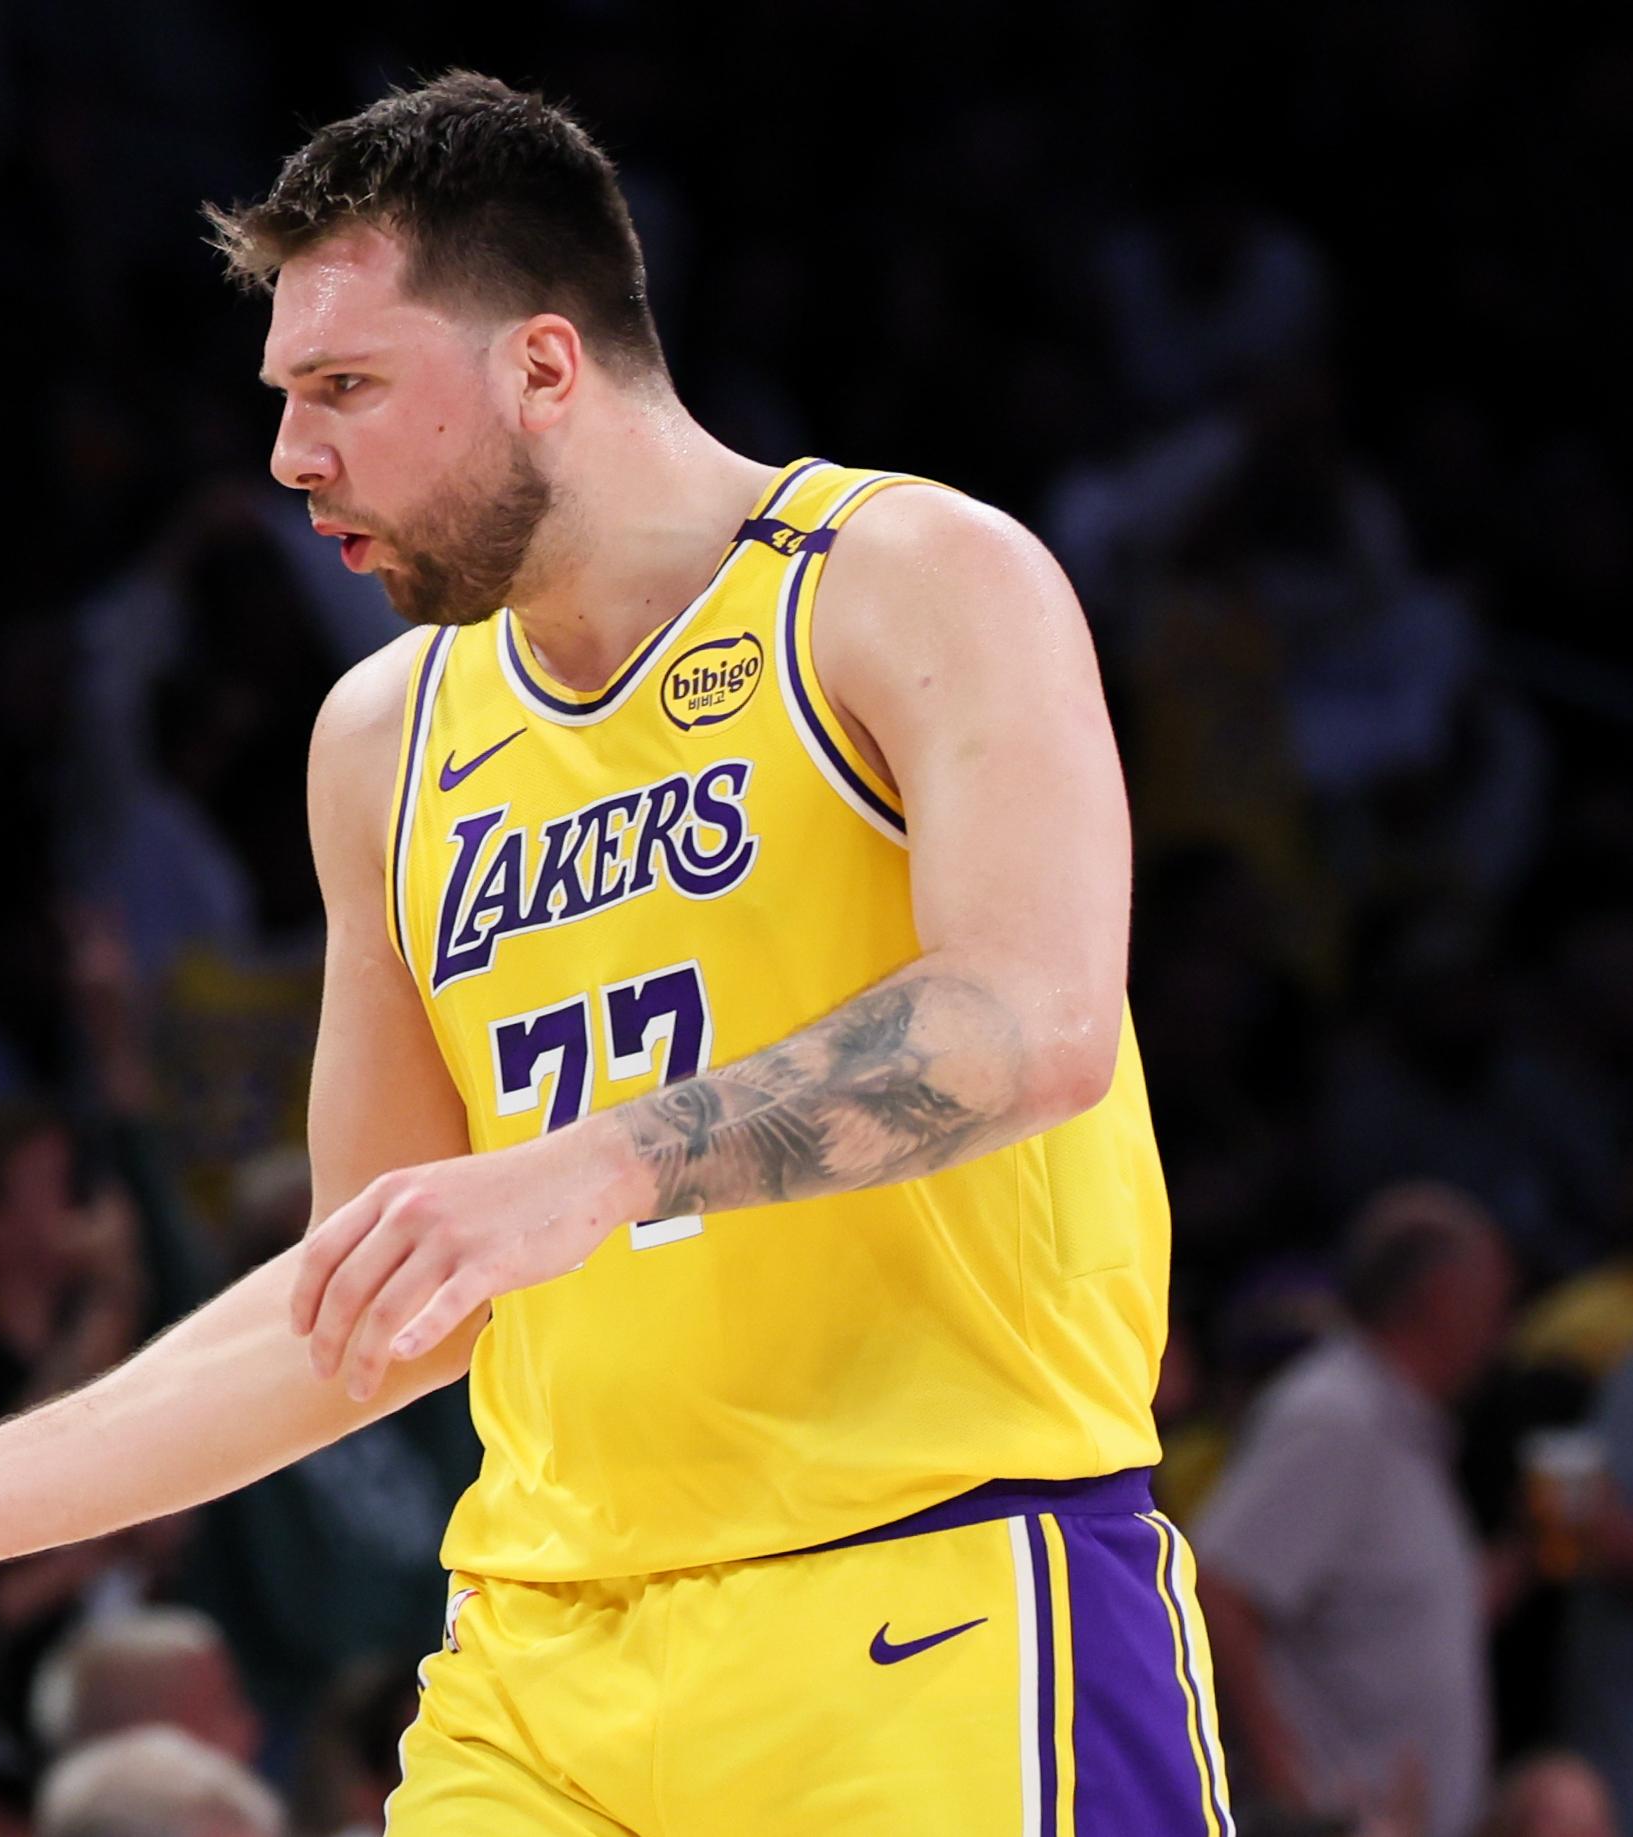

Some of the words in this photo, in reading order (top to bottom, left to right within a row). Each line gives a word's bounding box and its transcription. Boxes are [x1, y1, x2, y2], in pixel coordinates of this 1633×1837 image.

[772, 528, 807, 554] 44
[672, 657, 759, 700] bibigo
[687, 690, 726, 710] 비비고
[431, 757, 759, 998] LAKERS
[488, 958, 714, 1250] 77
